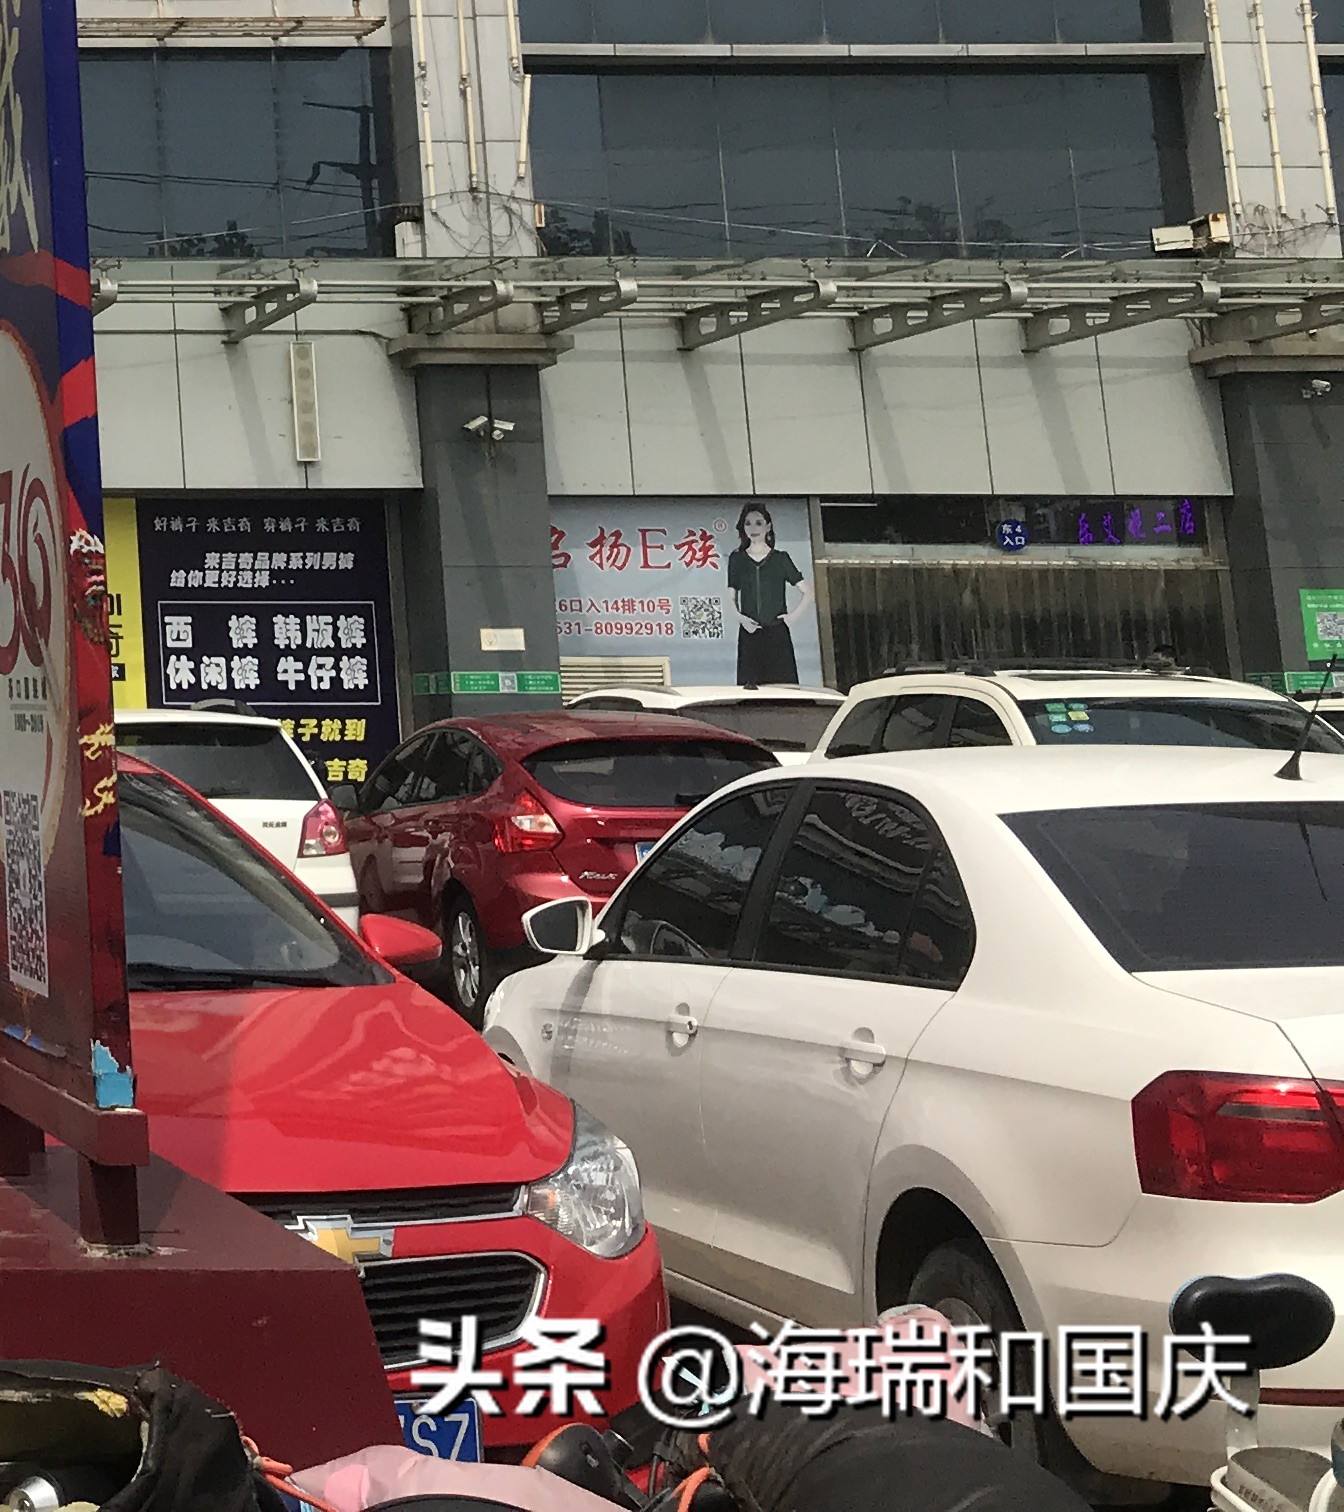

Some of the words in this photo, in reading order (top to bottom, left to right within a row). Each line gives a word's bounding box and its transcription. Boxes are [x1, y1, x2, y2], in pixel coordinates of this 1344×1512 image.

[1003, 536, 1025, 546] 入口
[276, 655, 368, 690] 牛仔裤
